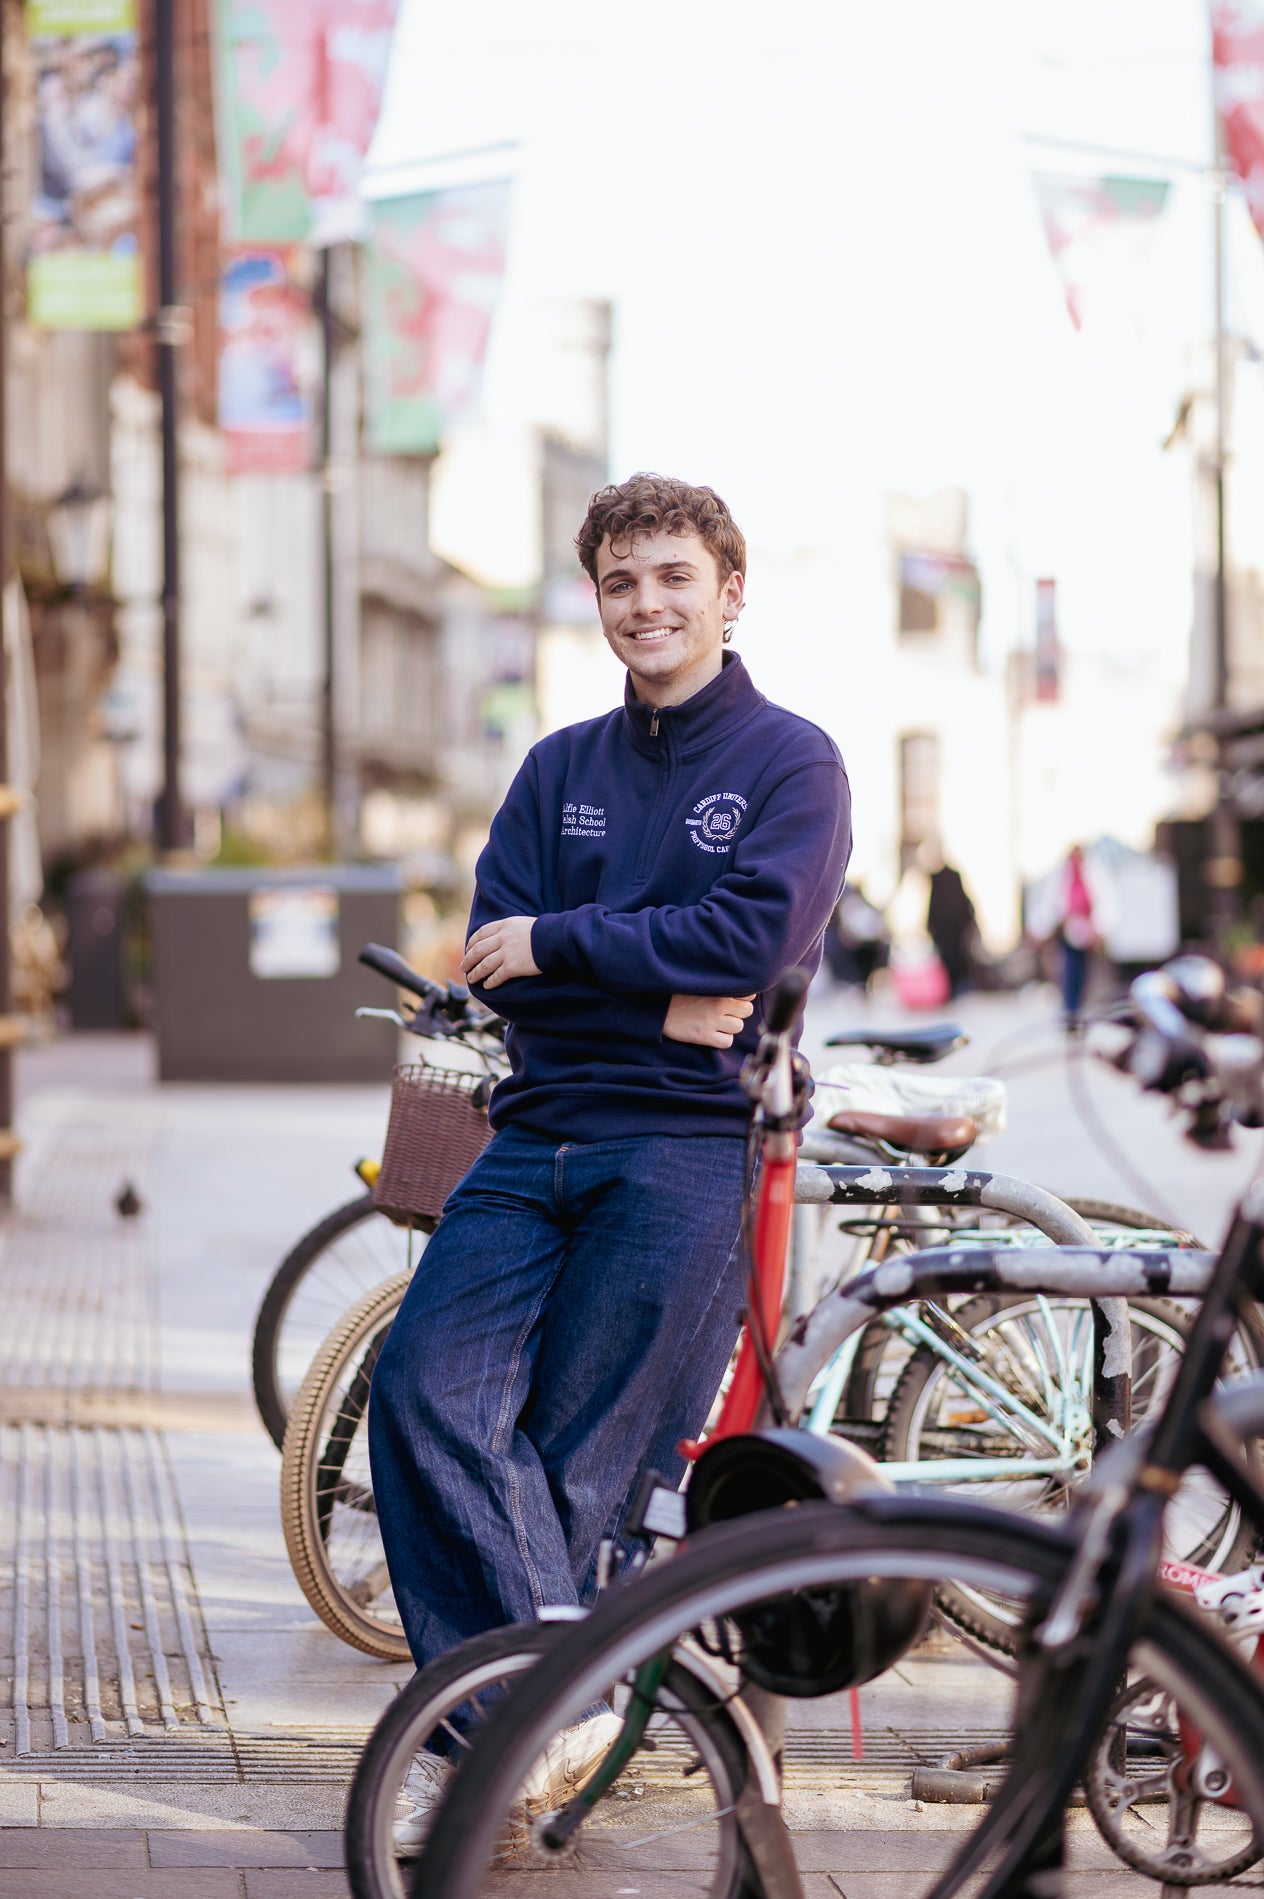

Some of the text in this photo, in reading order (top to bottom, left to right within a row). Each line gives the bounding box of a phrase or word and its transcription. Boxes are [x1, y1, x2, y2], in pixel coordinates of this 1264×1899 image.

[578, 804, 604, 816] Elliott
[693, 792, 749, 814] CARDIFF UNIVERS
[562, 814, 607, 827] elsh School
[710, 813, 732, 831] 26
